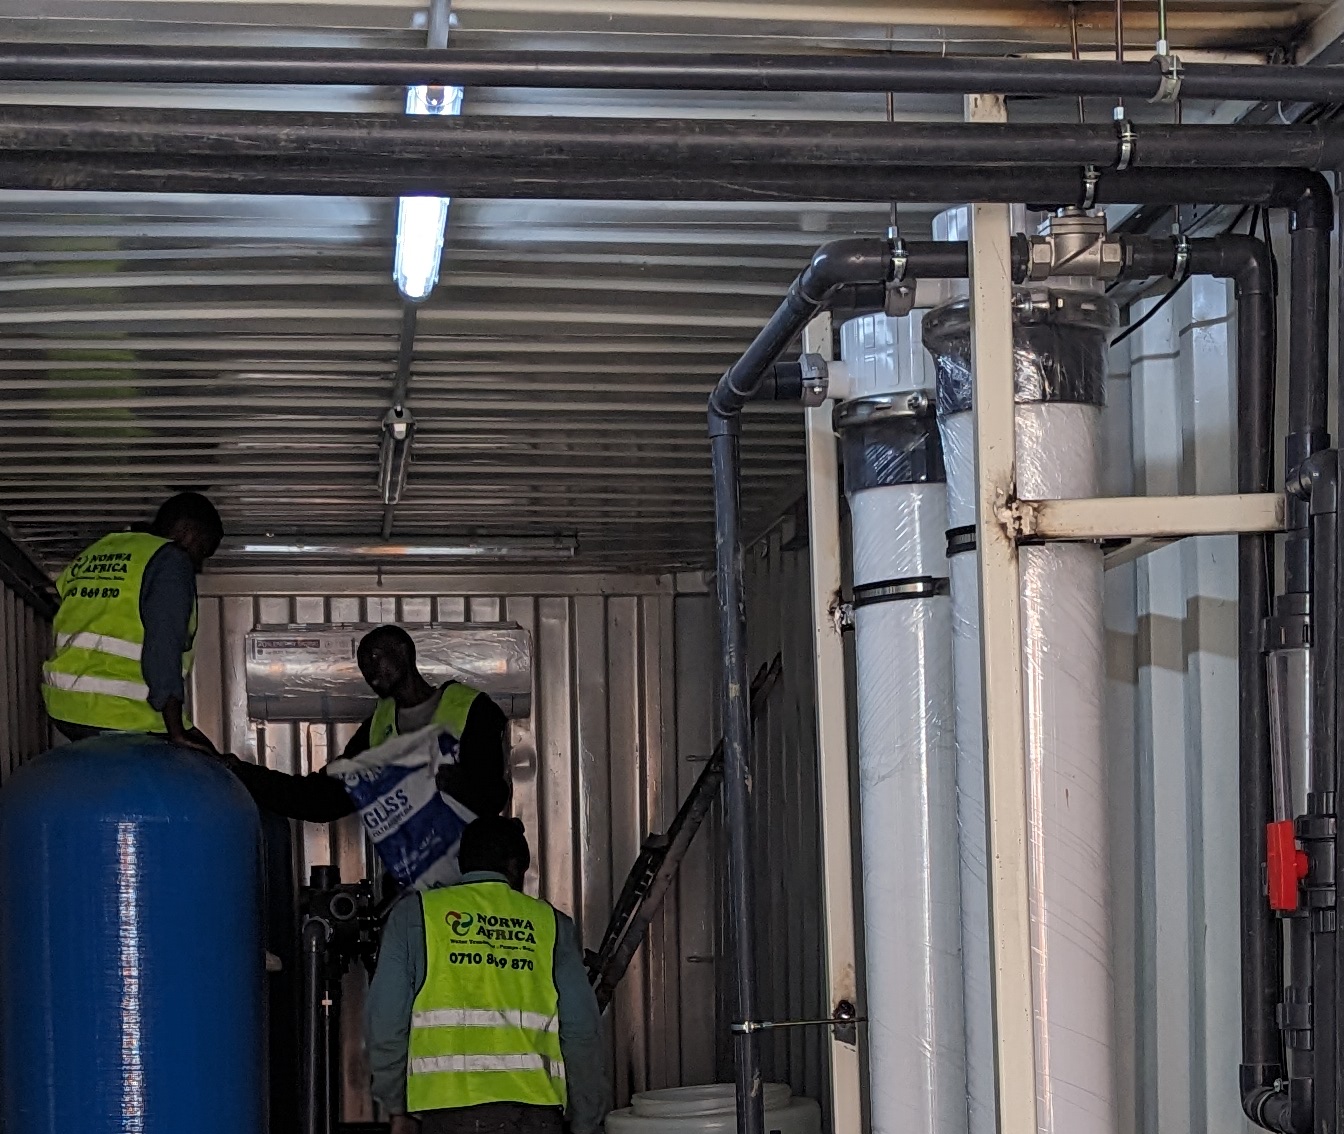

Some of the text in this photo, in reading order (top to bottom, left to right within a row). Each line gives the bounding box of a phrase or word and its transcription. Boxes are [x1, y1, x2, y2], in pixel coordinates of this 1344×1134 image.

[90, 553, 132, 563] NORWA
[83, 563, 128, 573] AFRICA
[476, 913, 534, 931] NORWA
[476, 925, 536, 944] AFRICA
[450, 952, 482, 965] 0710
[511, 958, 534, 971] 870
